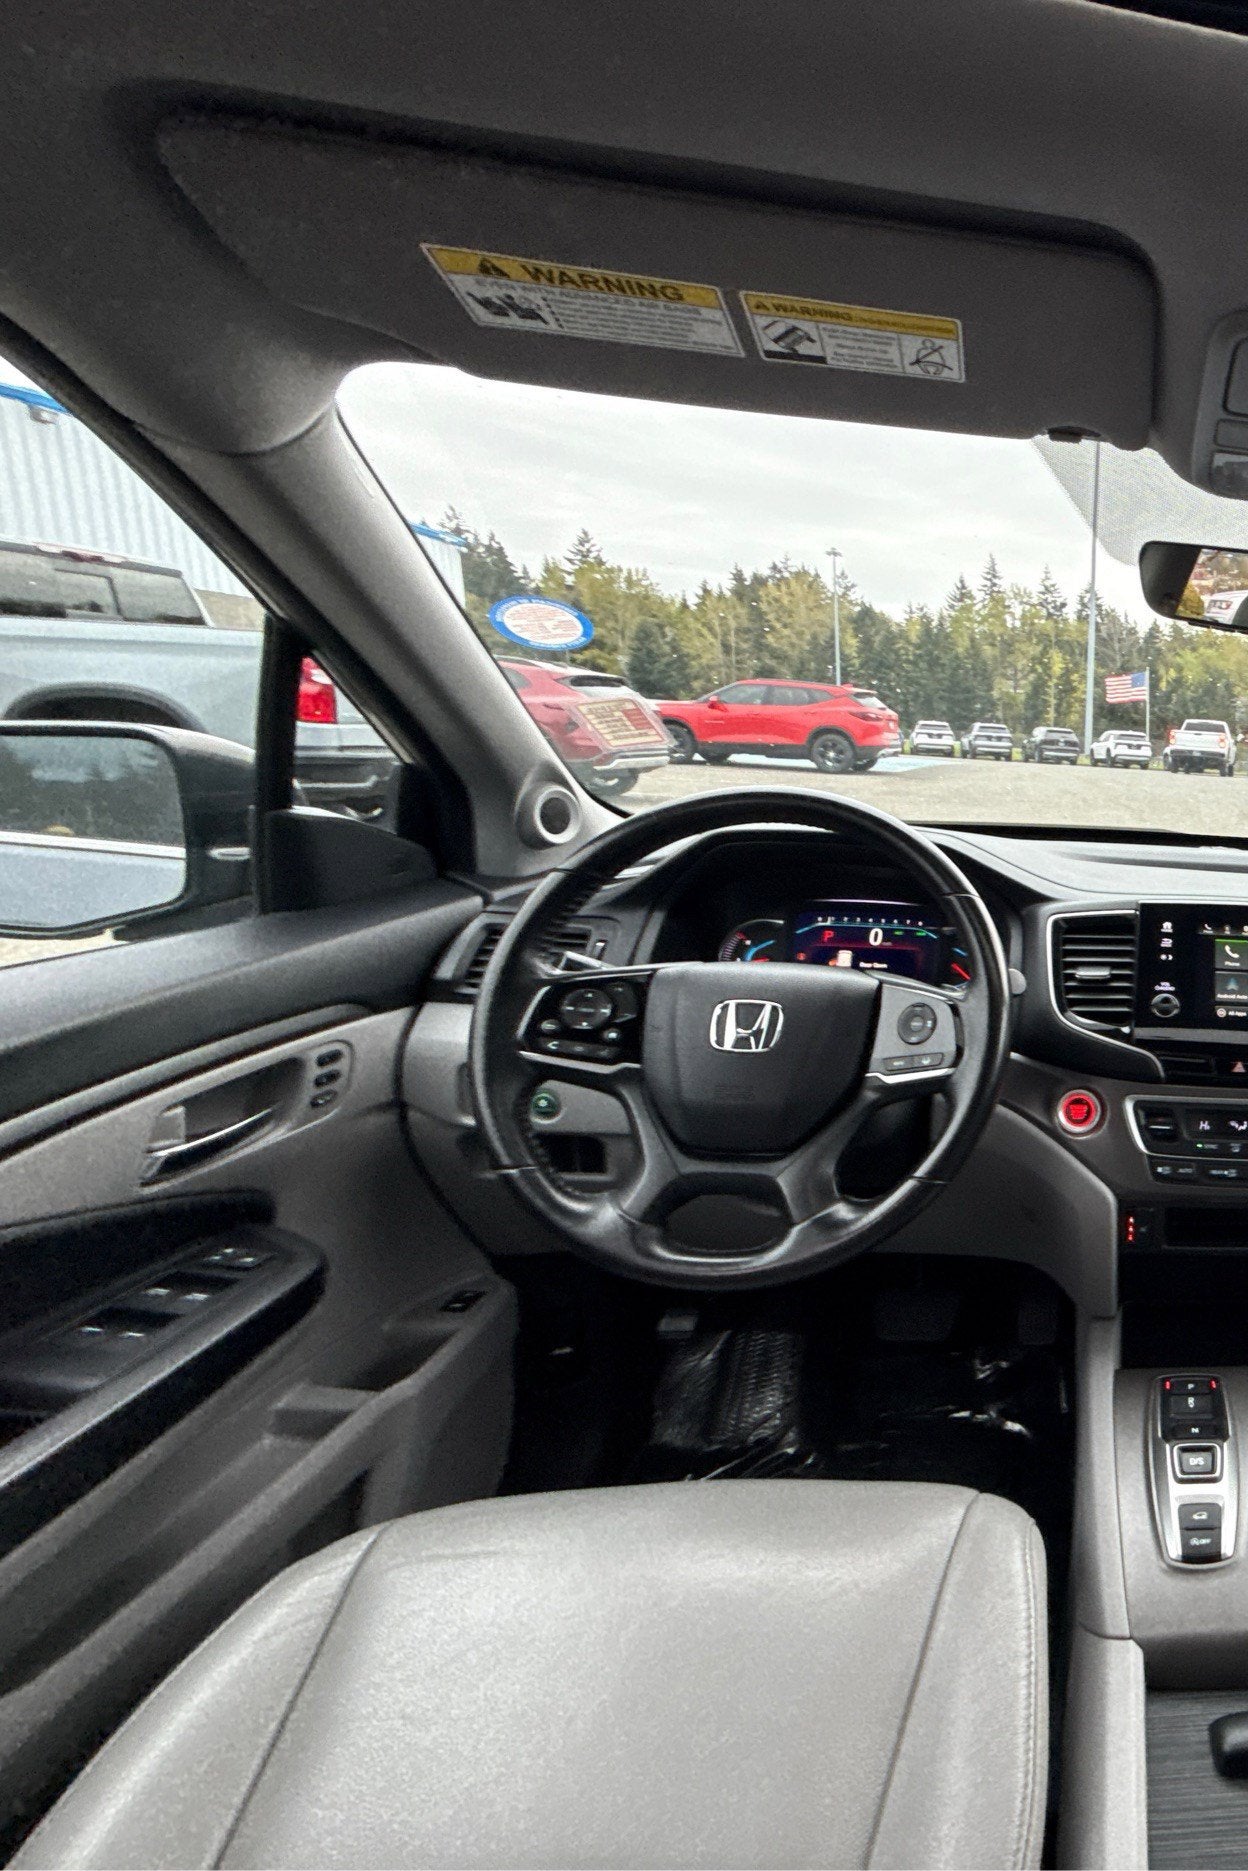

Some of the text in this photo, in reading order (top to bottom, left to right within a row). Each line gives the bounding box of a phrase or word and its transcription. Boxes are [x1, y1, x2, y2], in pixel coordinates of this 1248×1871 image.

[520, 263, 684, 302] WARNING
[772, 301, 853, 322] WARNING
[822, 930, 834, 943] P
[868, 928, 883, 946] 0
[1189, 1457, 1204, 1466] D/S
